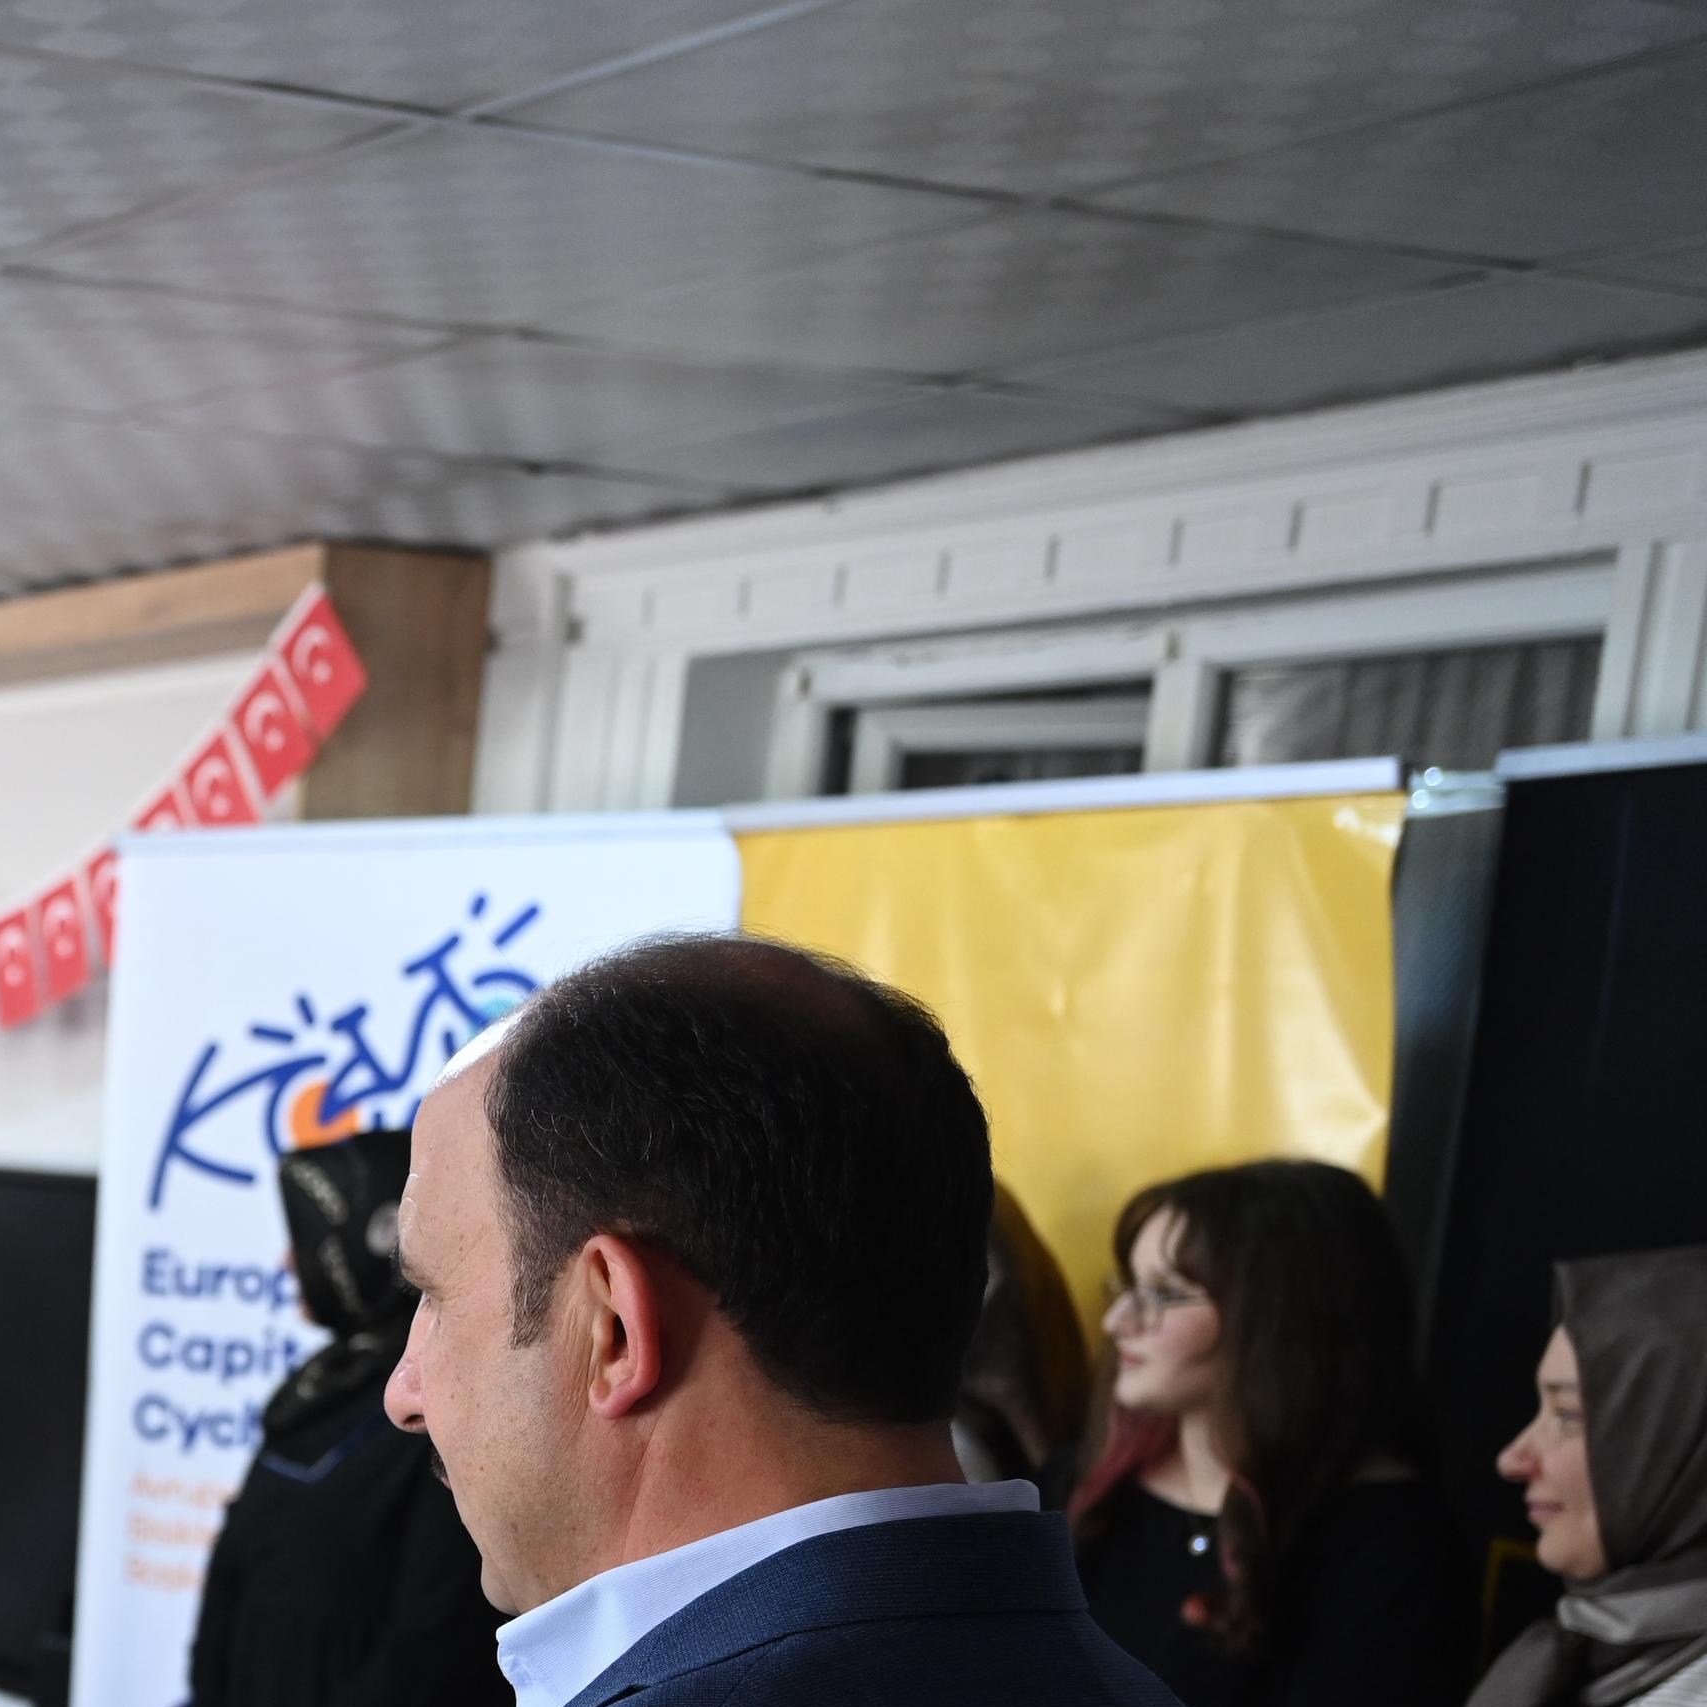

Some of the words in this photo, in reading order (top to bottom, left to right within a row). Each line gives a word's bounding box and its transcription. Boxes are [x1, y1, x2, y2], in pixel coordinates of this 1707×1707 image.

[143, 1248, 299, 1313] Europ
[138, 1322, 300, 1387] Capit
[133, 1394, 263, 1454] Cycl
